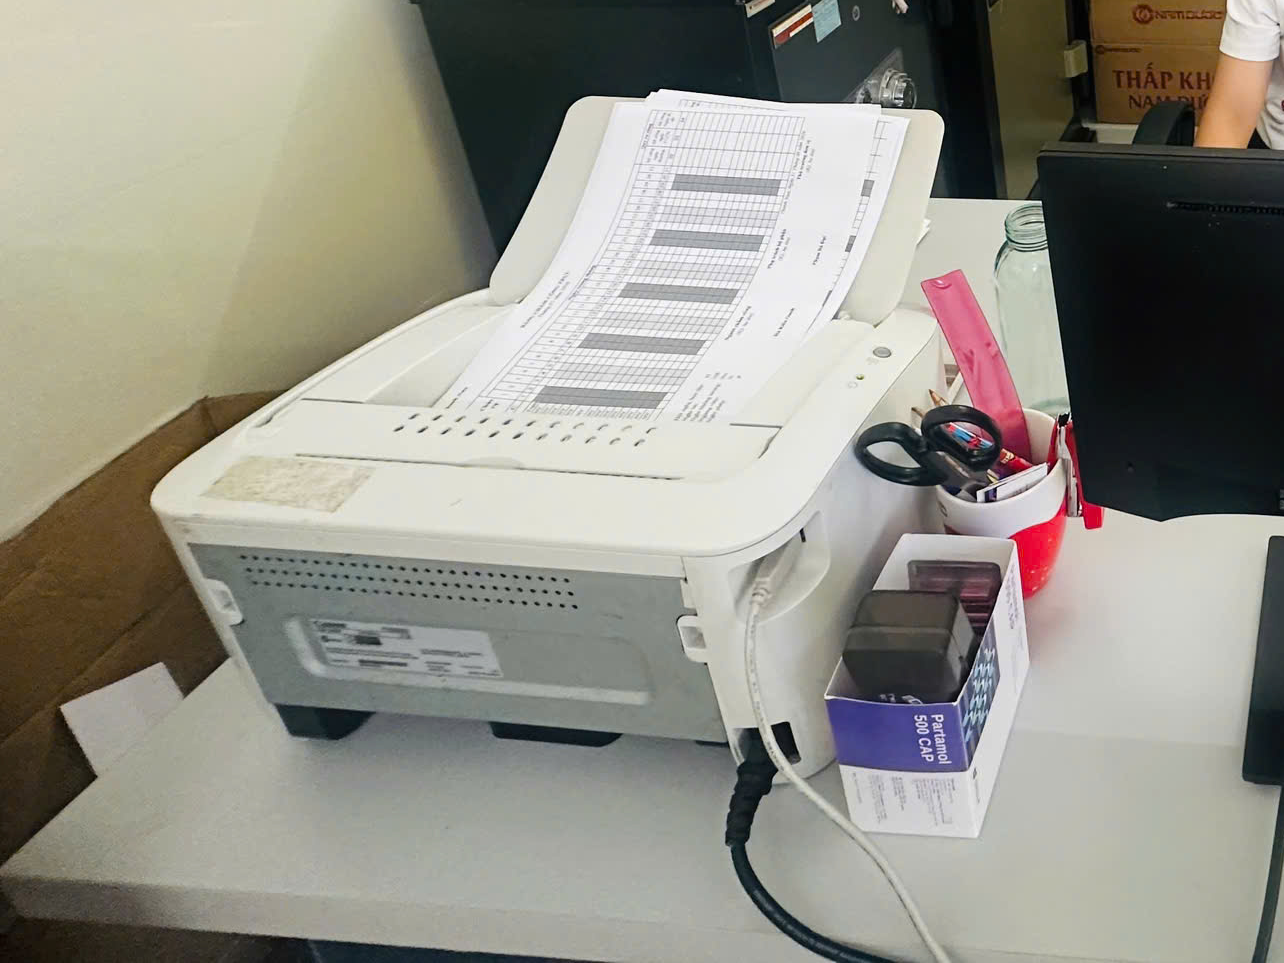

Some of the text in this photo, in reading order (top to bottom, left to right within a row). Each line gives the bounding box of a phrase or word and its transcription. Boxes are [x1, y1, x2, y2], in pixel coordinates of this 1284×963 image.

[1112, 62, 1173, 90] THẤP
[914, 714, 934, 762] 500 CAP
[931, 714, 952, 764] Partamol
